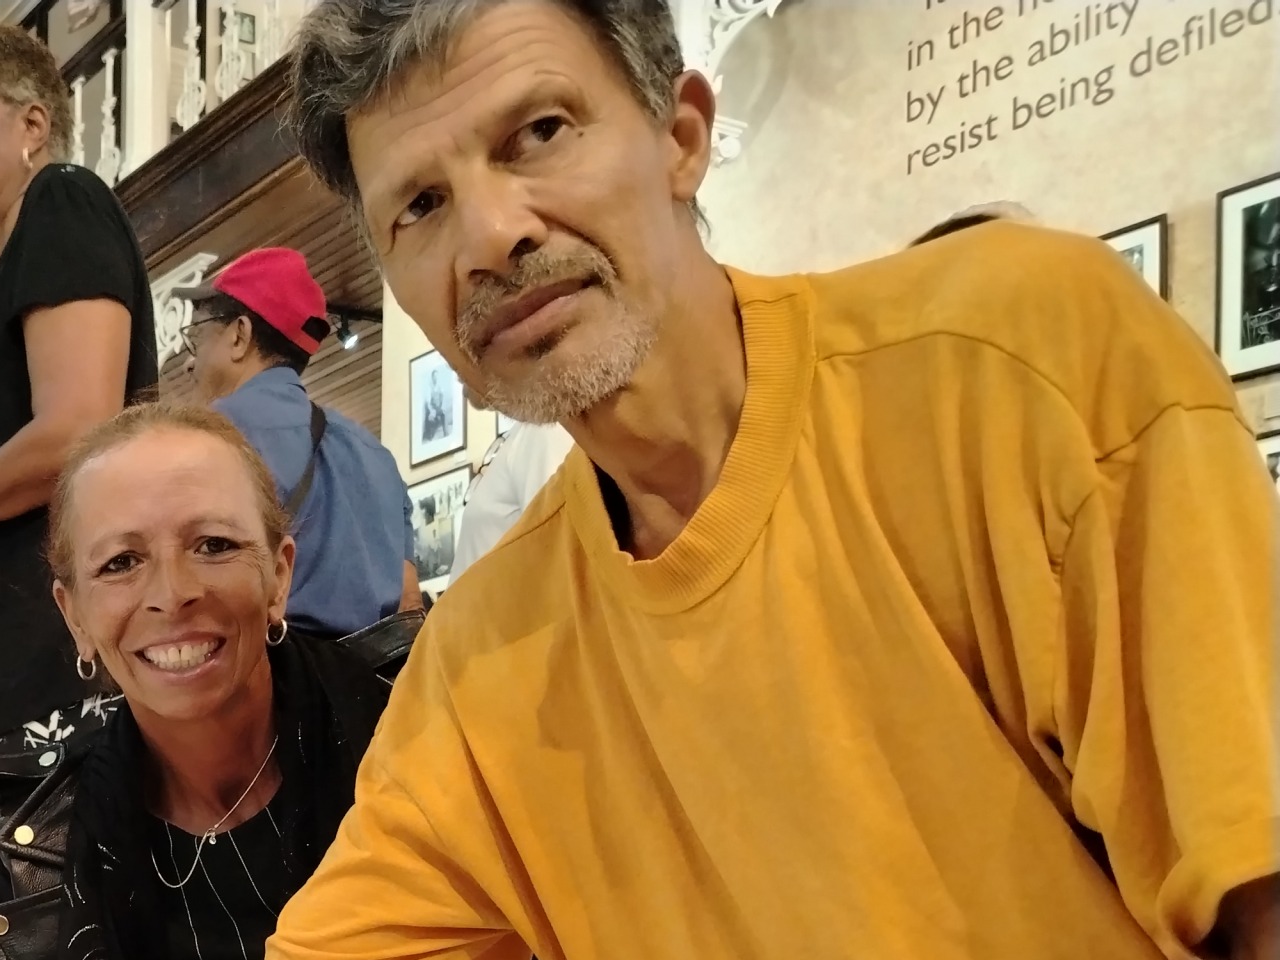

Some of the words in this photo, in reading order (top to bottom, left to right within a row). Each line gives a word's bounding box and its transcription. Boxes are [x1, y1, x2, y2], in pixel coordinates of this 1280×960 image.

[906, 41, 934, 71] in
[948, 6, 1003, 50] the
[906, 85, 945, 124] by
[957, 55, 1013, 98] the
[1027, 0, 1138, 67] ability
[906, 113, 998, 175] resist
[1012, 64, 1115, 130] being
